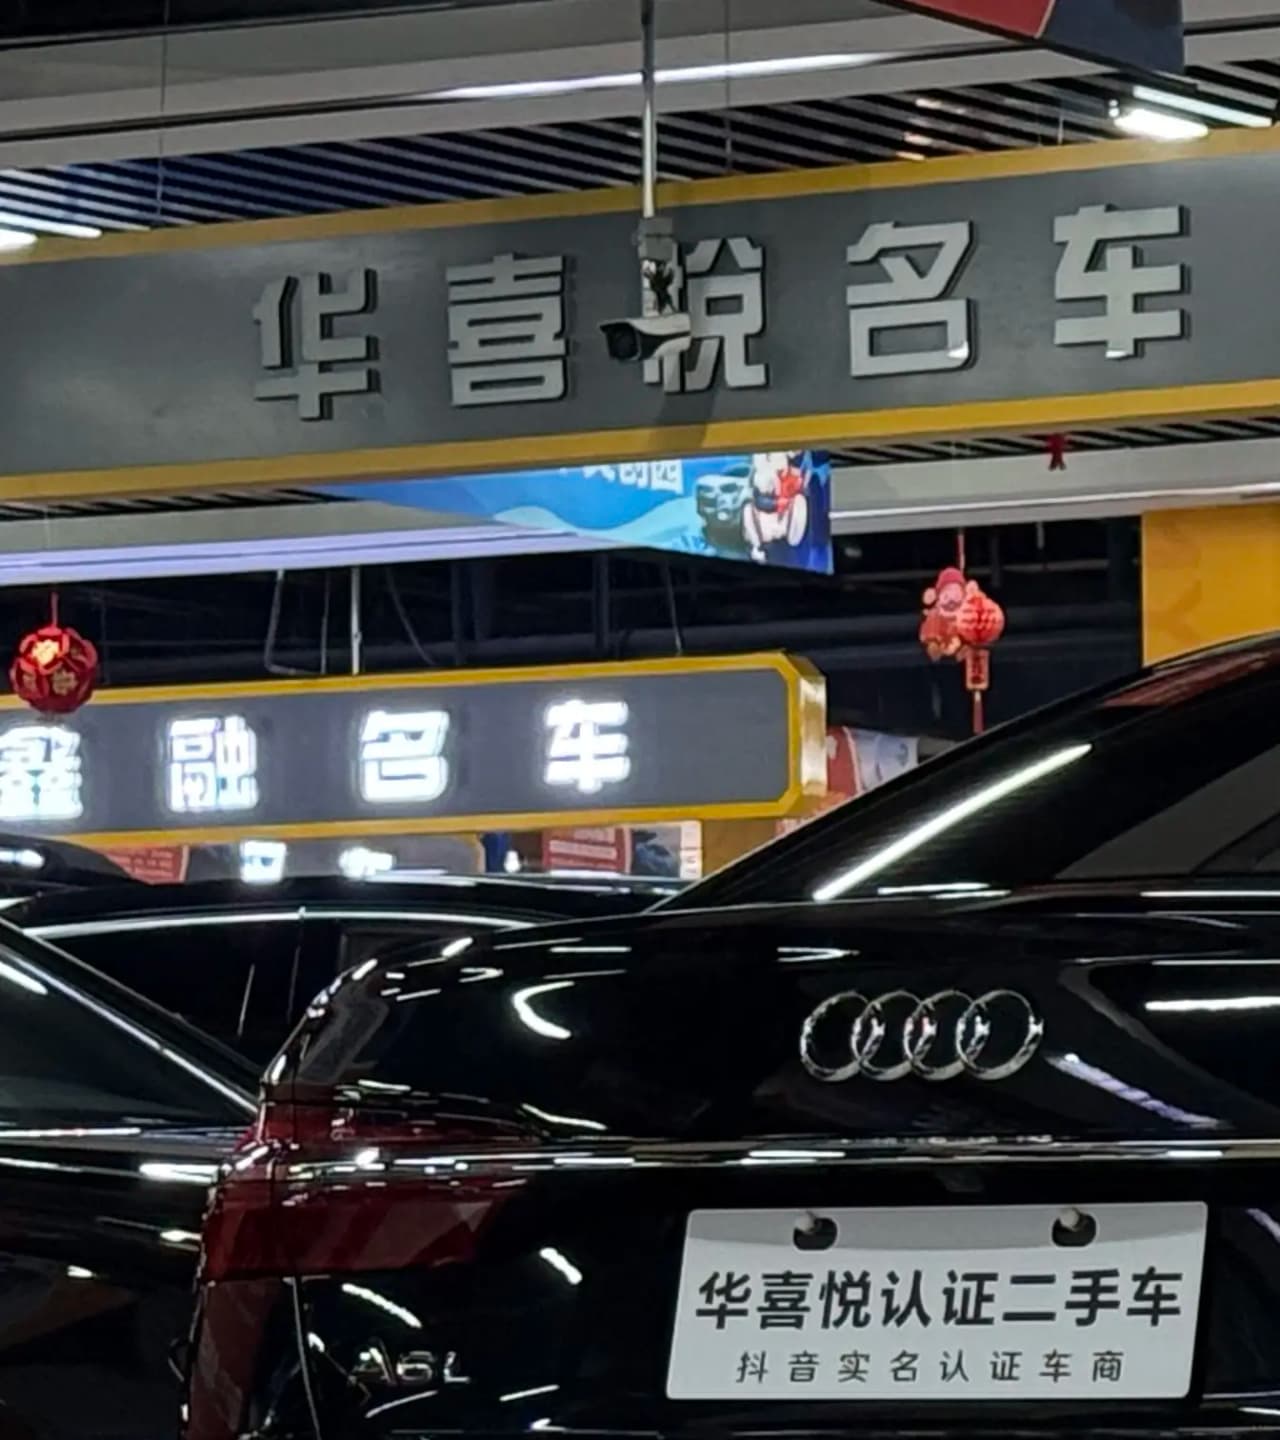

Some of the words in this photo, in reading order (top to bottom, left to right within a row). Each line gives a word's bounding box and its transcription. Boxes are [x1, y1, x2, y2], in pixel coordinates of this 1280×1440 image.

[252, 202, 1188, 420] 华喜悦名车
[0, 700, 631, 820] 鑫融名车
[695, 1265, 1184, 1331] 华喜悦认证二手车
[352, 1340, 471, 1385] A6L
[735, 1349, 1125, 1384] 抖音实名认证车商
